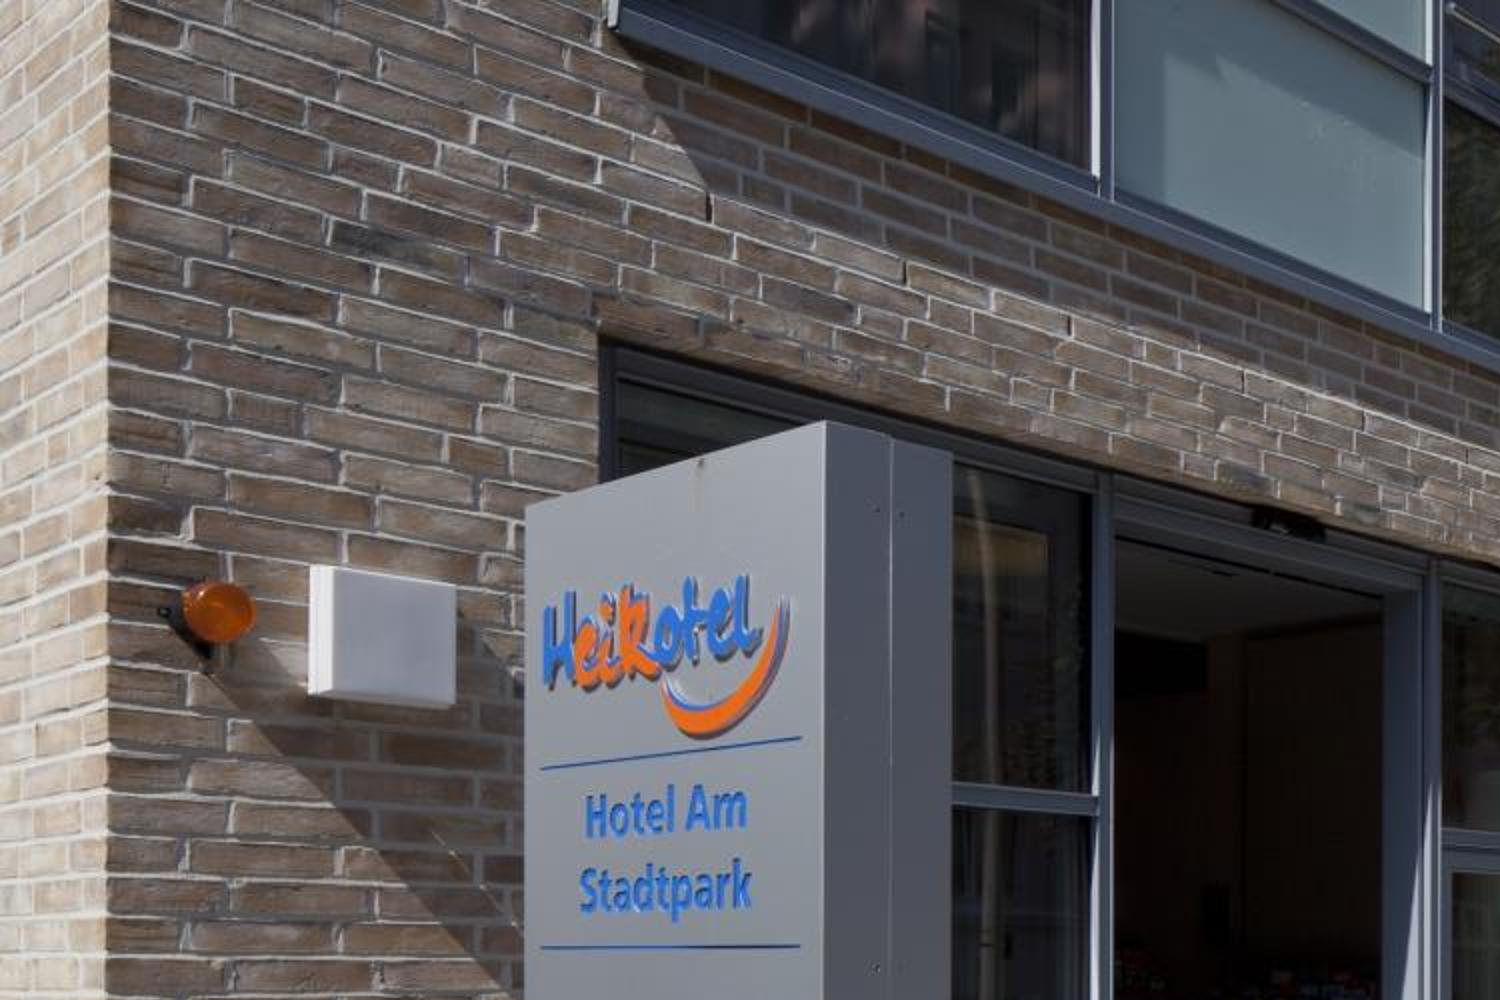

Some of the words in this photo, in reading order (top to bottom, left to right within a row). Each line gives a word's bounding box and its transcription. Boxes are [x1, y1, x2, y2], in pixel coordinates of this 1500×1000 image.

[585, 784, 675, 838] Hotel
[685, 784, 748, 832] Am
[579, 858, 752, 922] Stadtpark
